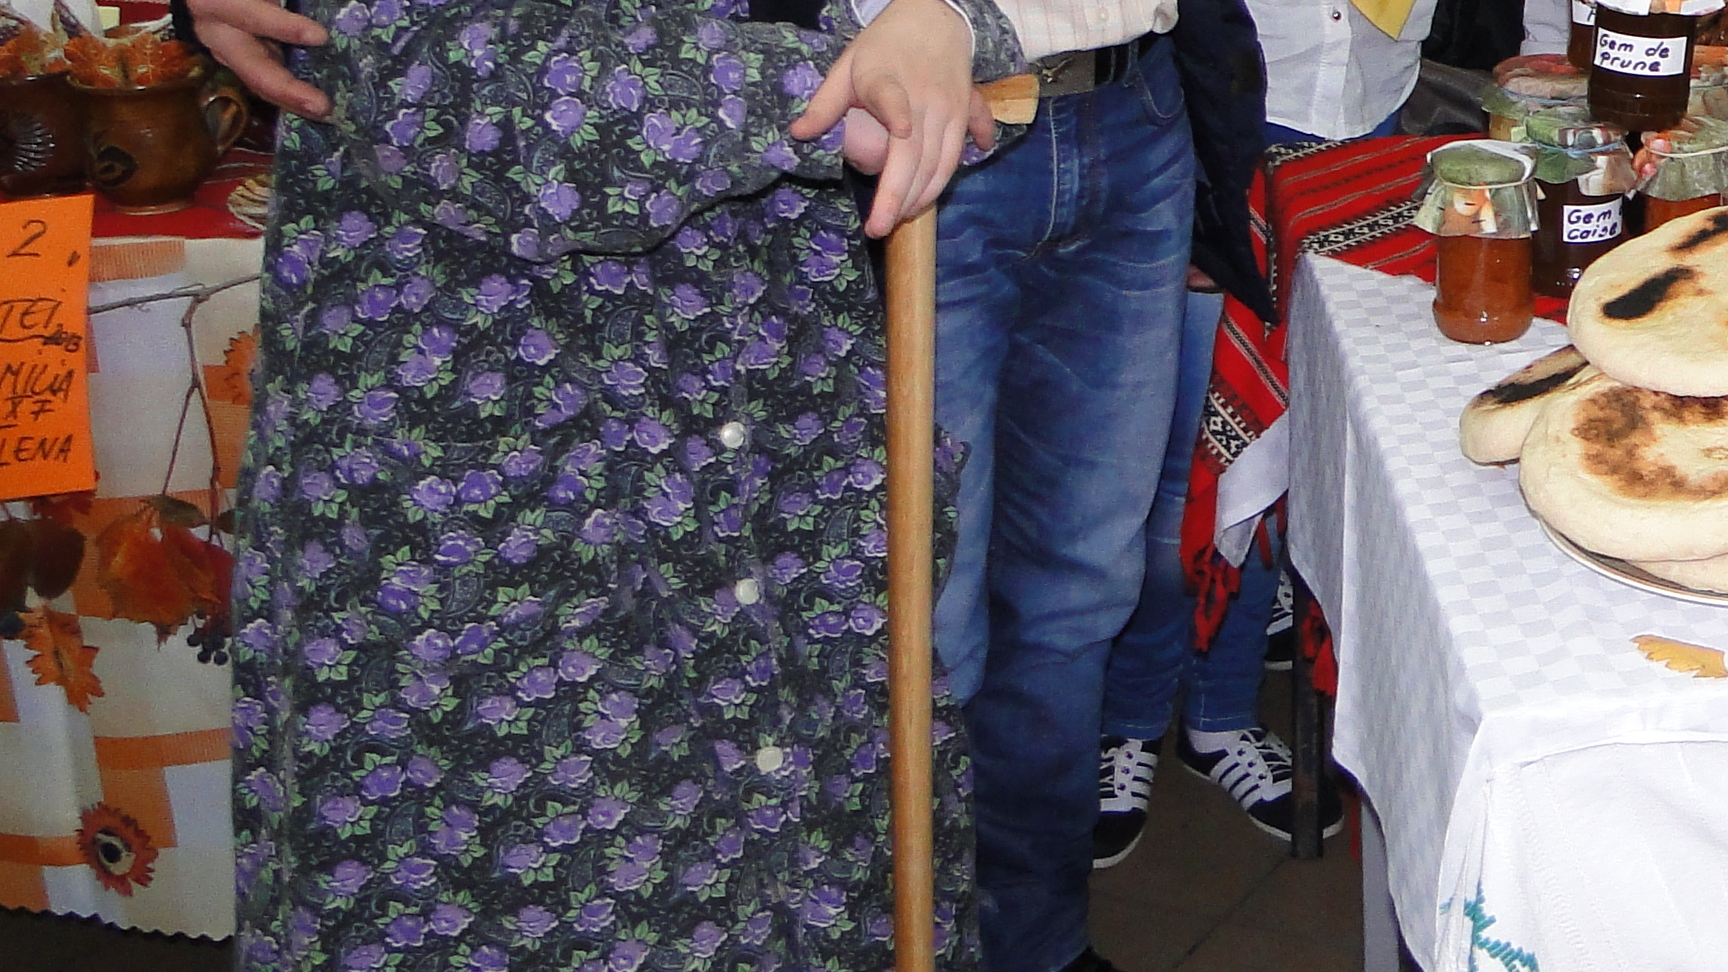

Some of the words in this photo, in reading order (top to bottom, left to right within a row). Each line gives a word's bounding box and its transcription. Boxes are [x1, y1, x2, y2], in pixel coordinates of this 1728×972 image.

[1599, 33, 1634, 54] Gem
[1645, 41, 1670, 59] de
[1567, 208, 1613, 225] Gem
[6, 218, 48, 259] 2
